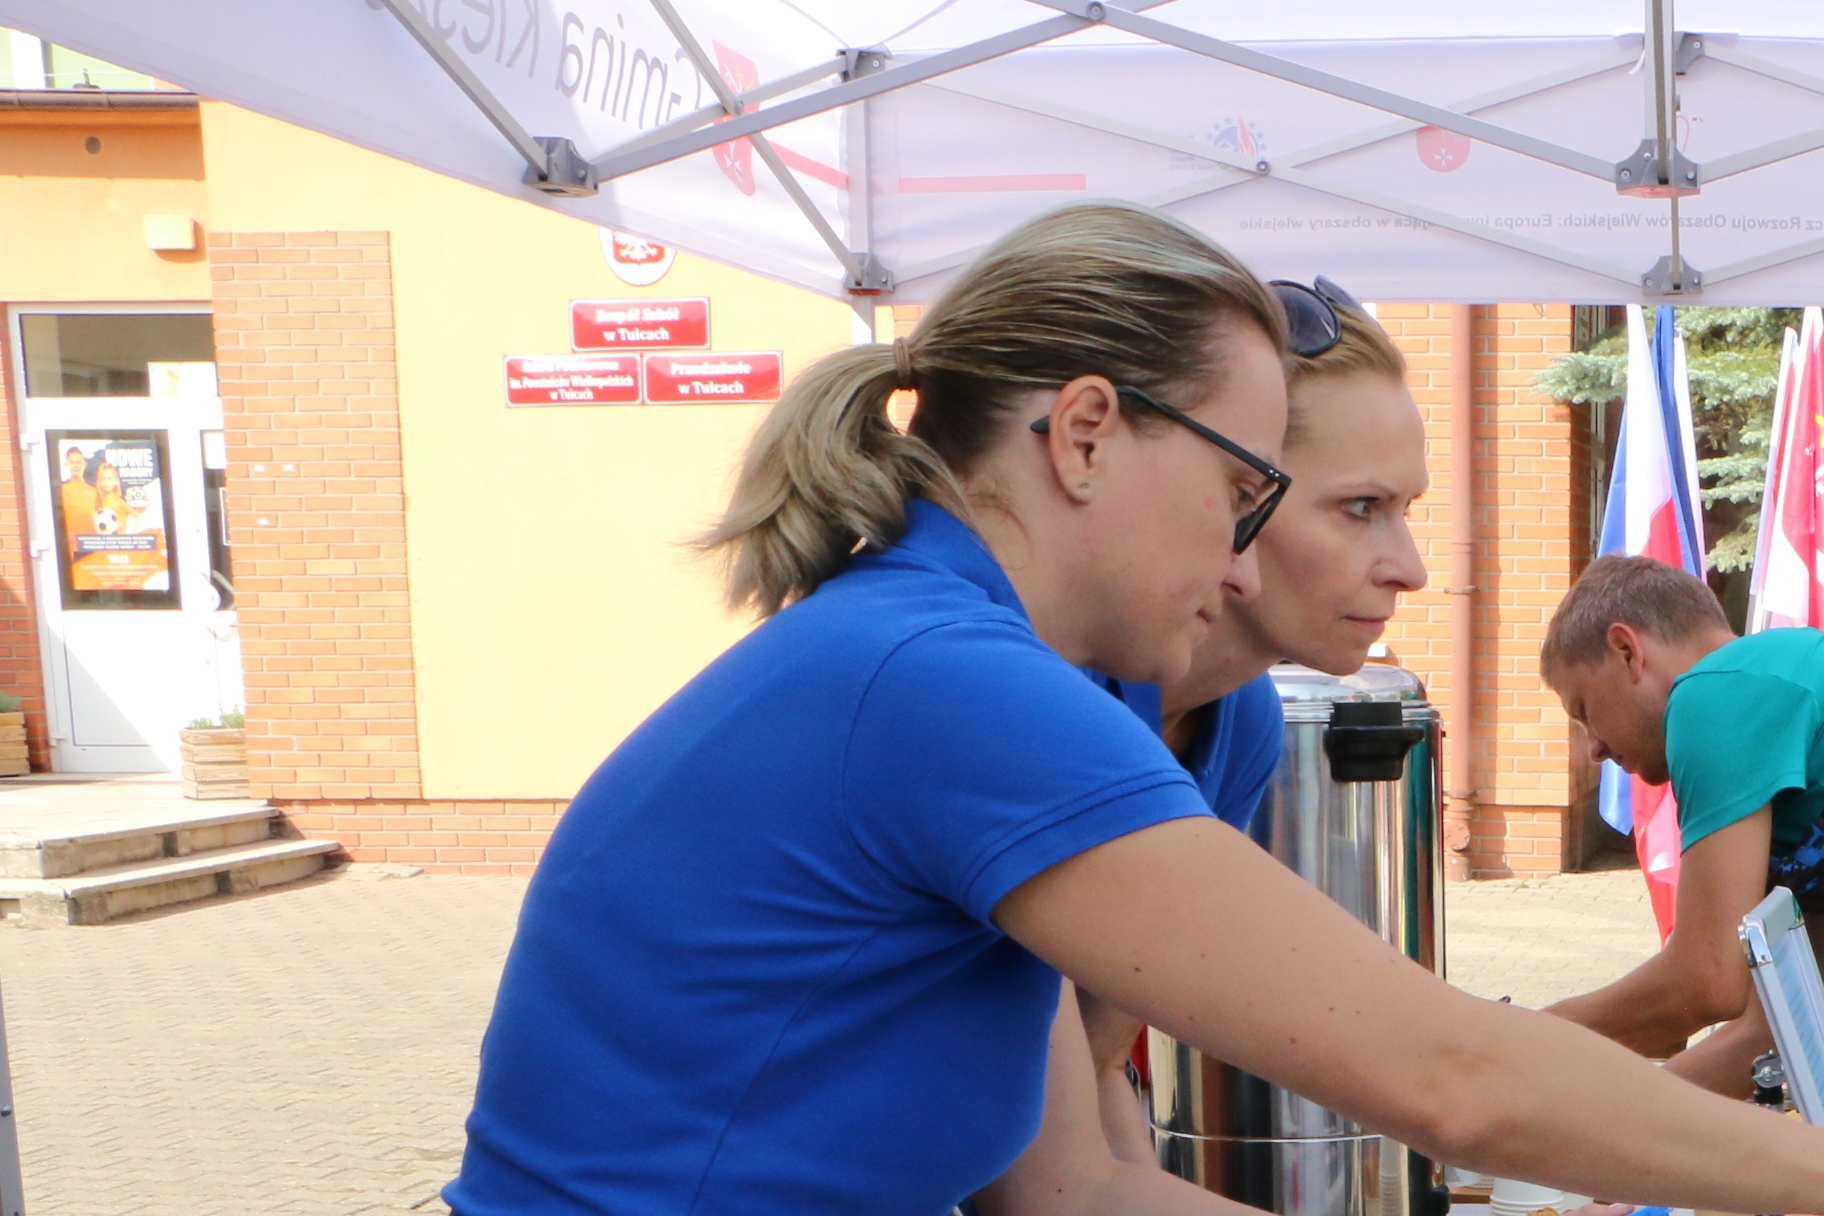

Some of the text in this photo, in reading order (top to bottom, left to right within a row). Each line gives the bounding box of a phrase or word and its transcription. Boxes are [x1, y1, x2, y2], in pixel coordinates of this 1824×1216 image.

[595, 306, 680, 324] Zespół Szkół
[603, 327, 670, 341] w Tulcach
[669, 361, 752, 376] Przedszkole
[571, 375, 634, 390] Wielkopolskich
[678, 381, 744, 395] w Tulcach
[557, 389, 594, 401] Tulcach
[105, 448, 154, 467] NOWE
